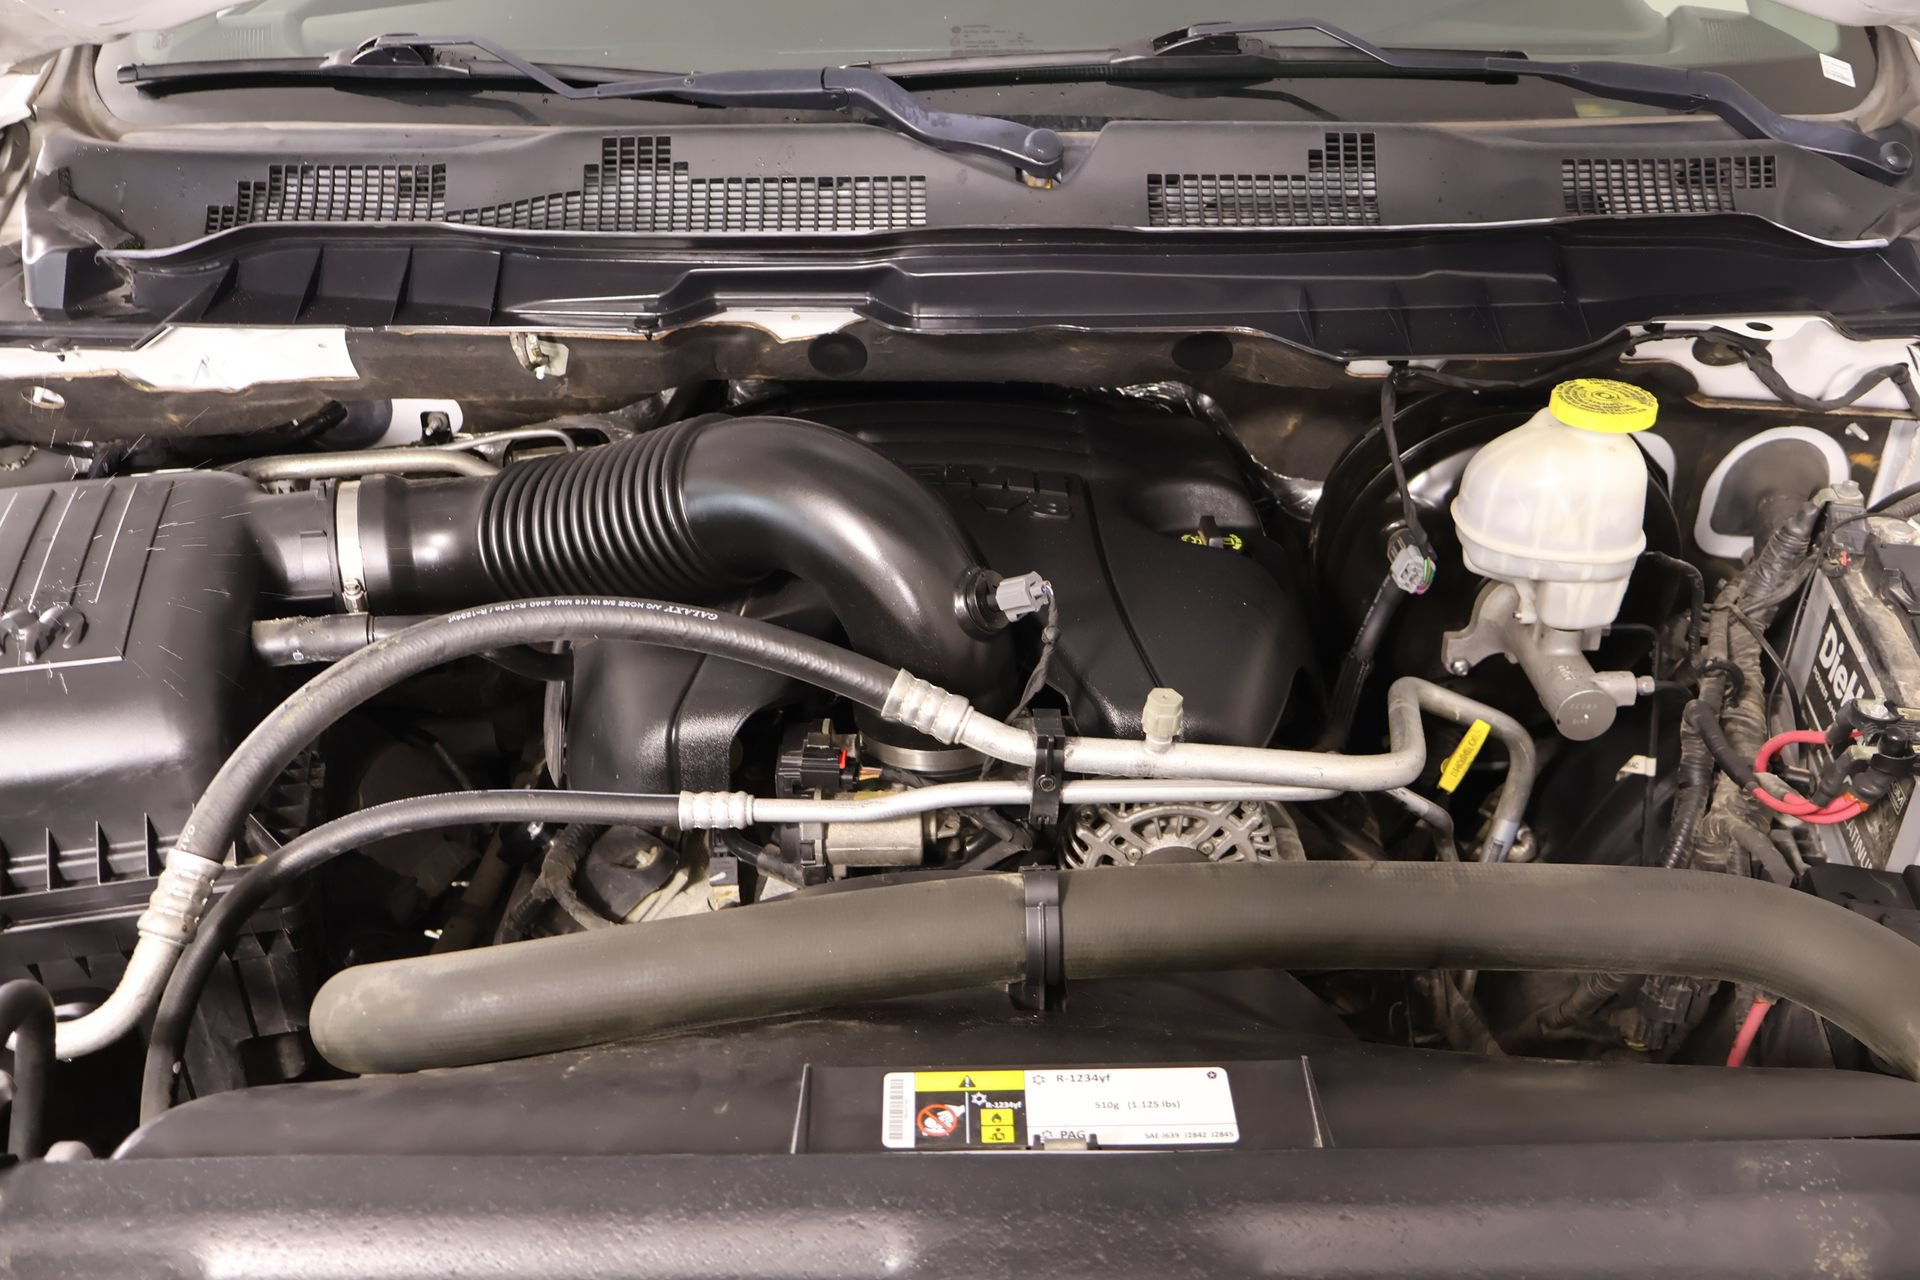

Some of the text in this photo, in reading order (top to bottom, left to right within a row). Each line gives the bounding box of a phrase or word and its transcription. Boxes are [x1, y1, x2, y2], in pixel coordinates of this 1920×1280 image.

[590, 598, 600, 606] IN
[618, 599, 644, 609] HOSE
[646, 602, 662, 611] A/C
[664, 605, 719, 621] GALAXY
[1819, 622, 1865, 706] DieH
[1844, 818, 1873, 869] ATINU
[1056, 1073, 1111, 1084] R-1234yf
[1095, 1099, 1181, 1110] 510g (1.125 lbs)
[1060, 1130, 1086, 1139] PAG
